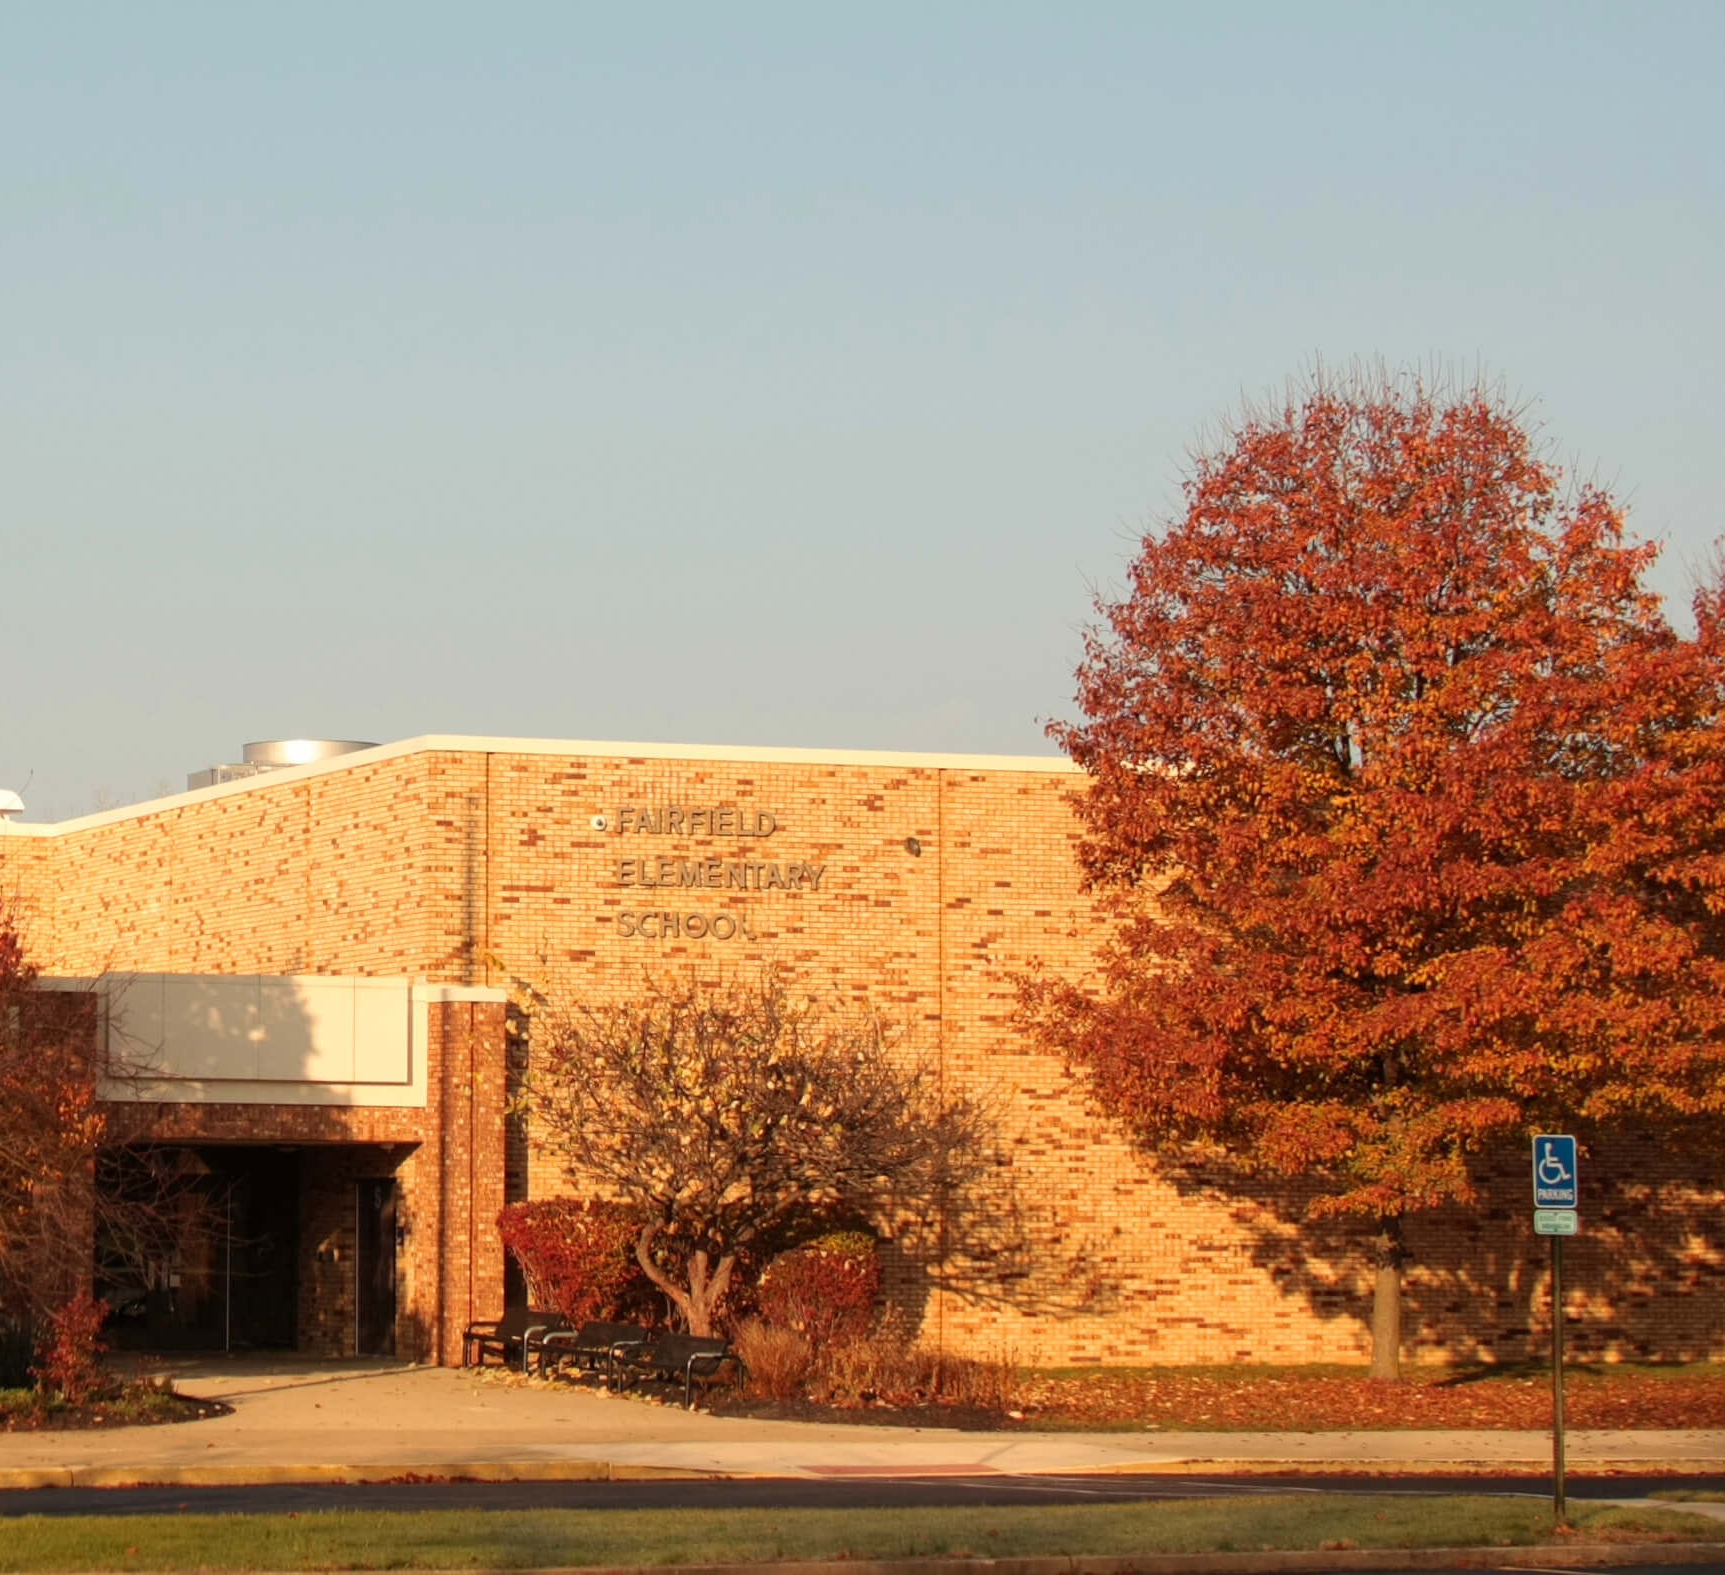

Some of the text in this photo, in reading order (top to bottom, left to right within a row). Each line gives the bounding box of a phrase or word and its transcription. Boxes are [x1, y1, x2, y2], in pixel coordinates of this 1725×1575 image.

[616, 807, 776, 837] FAIRFIELD
[617, 858, 826, 890] ELEMENTARY
[616, 911, 757, 941] SCHOOL
[1538, 1189, 1574, 1200] PARKING
